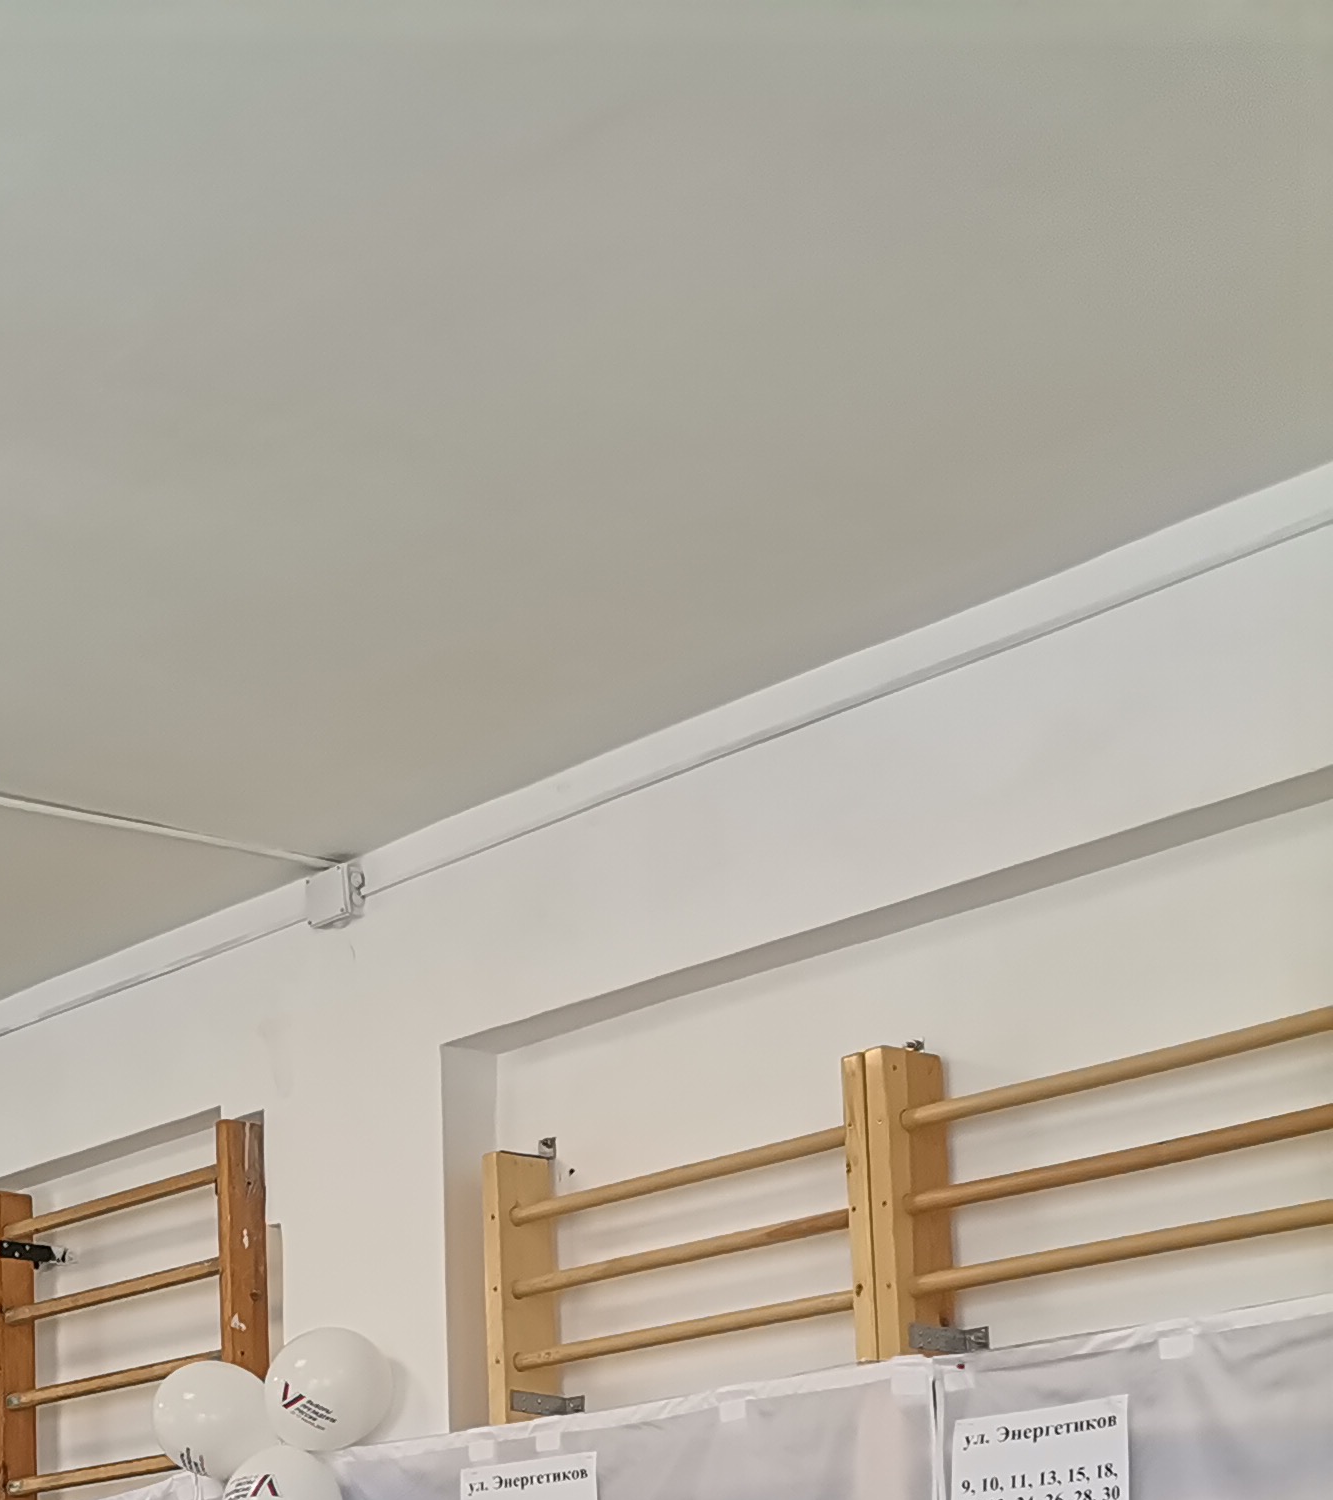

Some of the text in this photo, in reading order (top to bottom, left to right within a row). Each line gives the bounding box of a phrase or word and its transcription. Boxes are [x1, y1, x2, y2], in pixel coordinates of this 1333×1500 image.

[963, 1415, 1118, 1451] ул. Энергетиков
[467, 1468, 589, 1496] ул. Энергетиков
[961, 1462, 1118, 1495] 9, 10, 11, 13, 15, 18,
